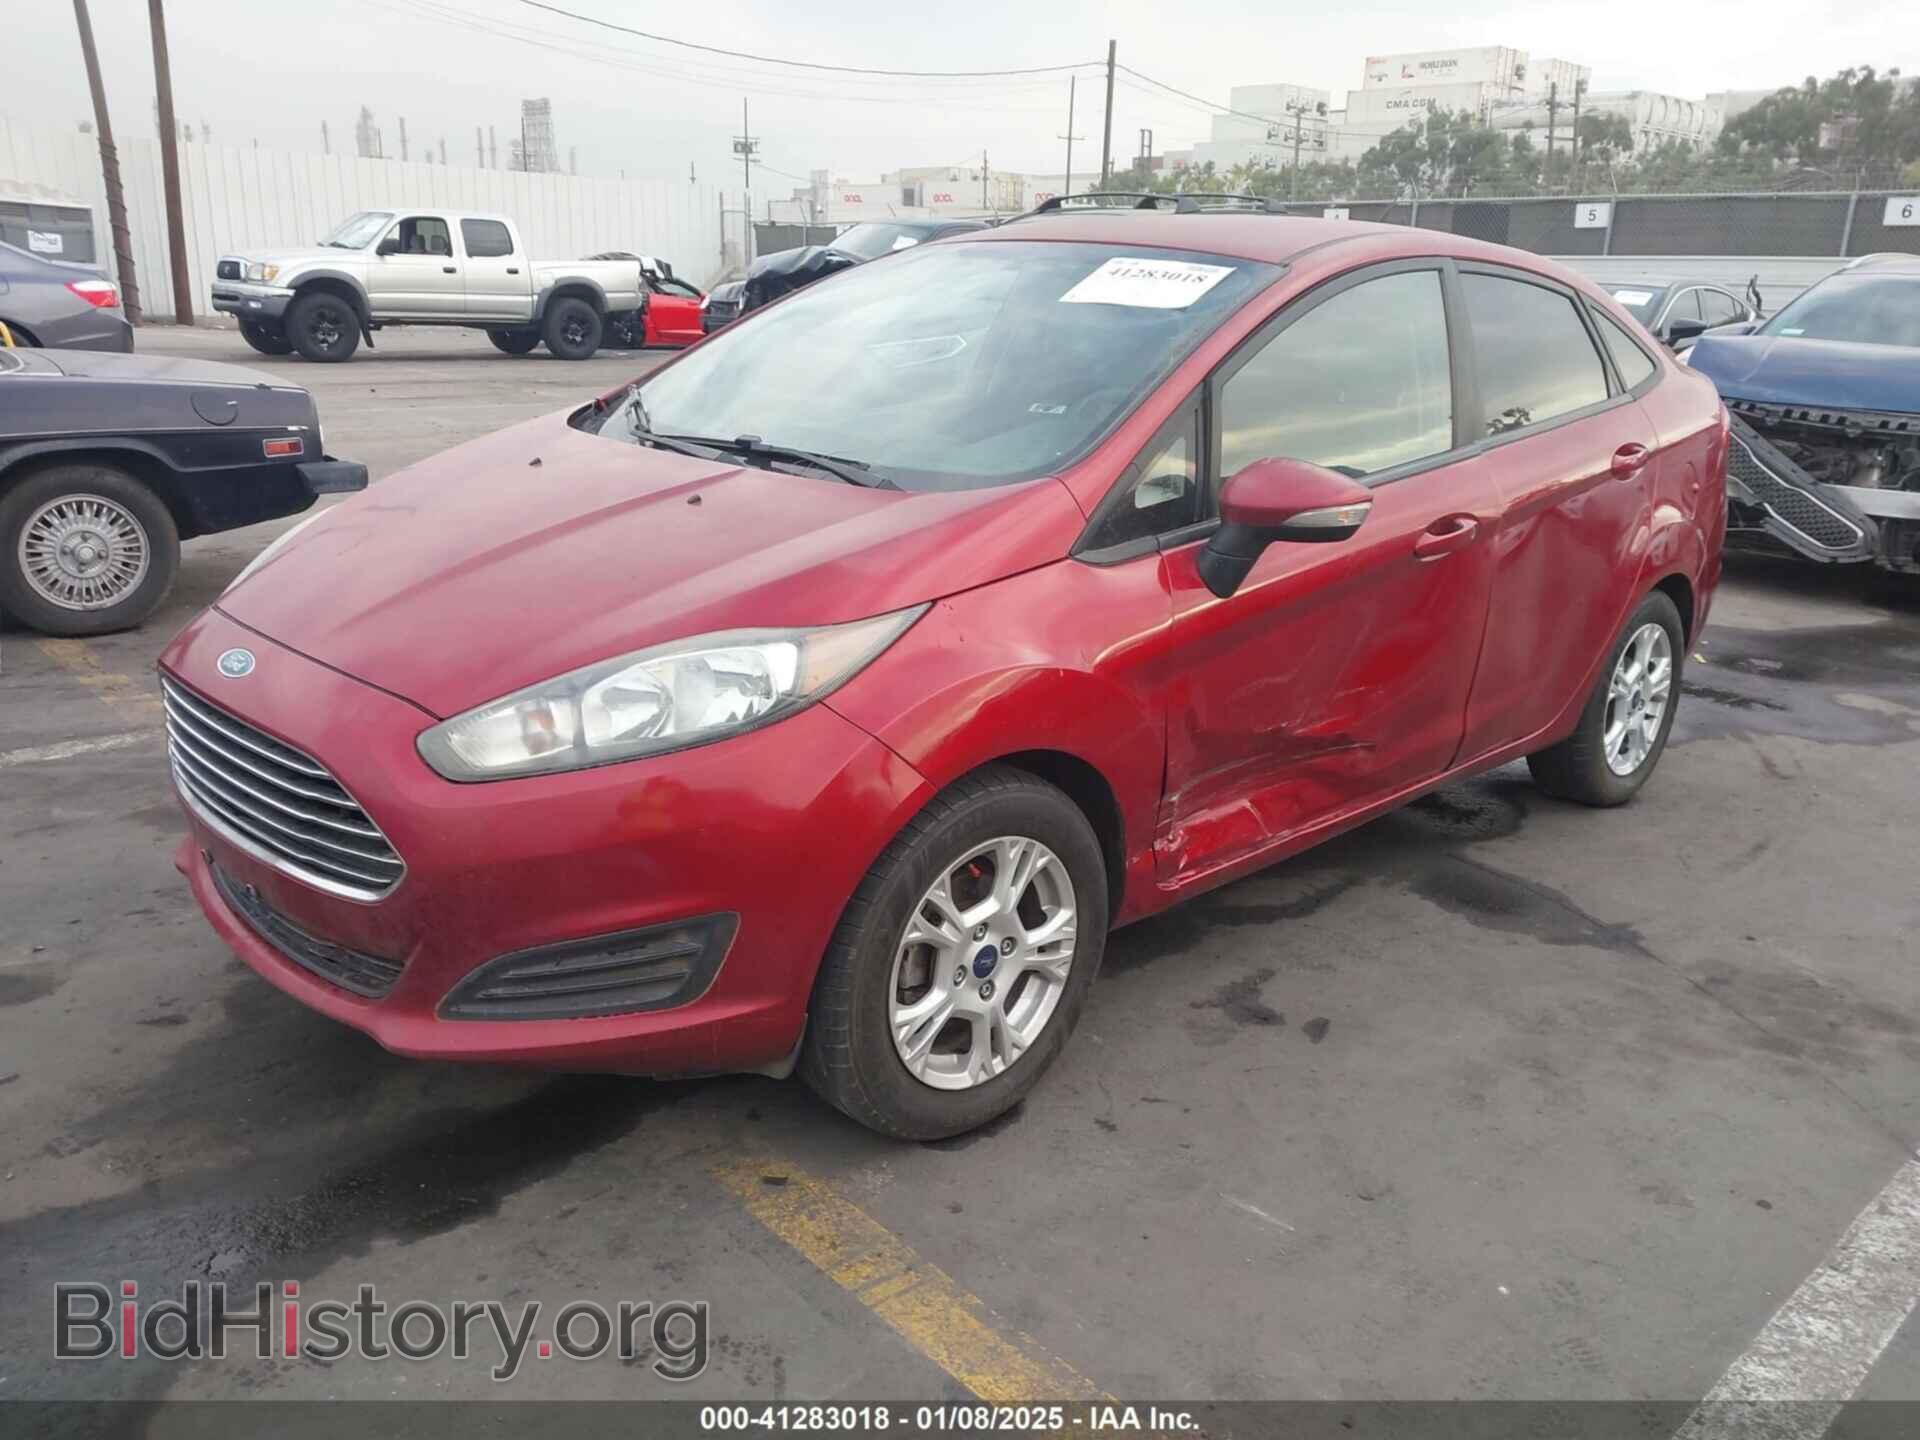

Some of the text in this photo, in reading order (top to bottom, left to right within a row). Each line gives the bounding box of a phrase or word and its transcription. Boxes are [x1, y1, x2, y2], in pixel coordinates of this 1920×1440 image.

[1386, 100, 1409, 110] CMA
[1588, 209, 1597, 222] 5
[1901, 203, 1913, 219] 6
[1108, 266, 1209, 284] 41283018
